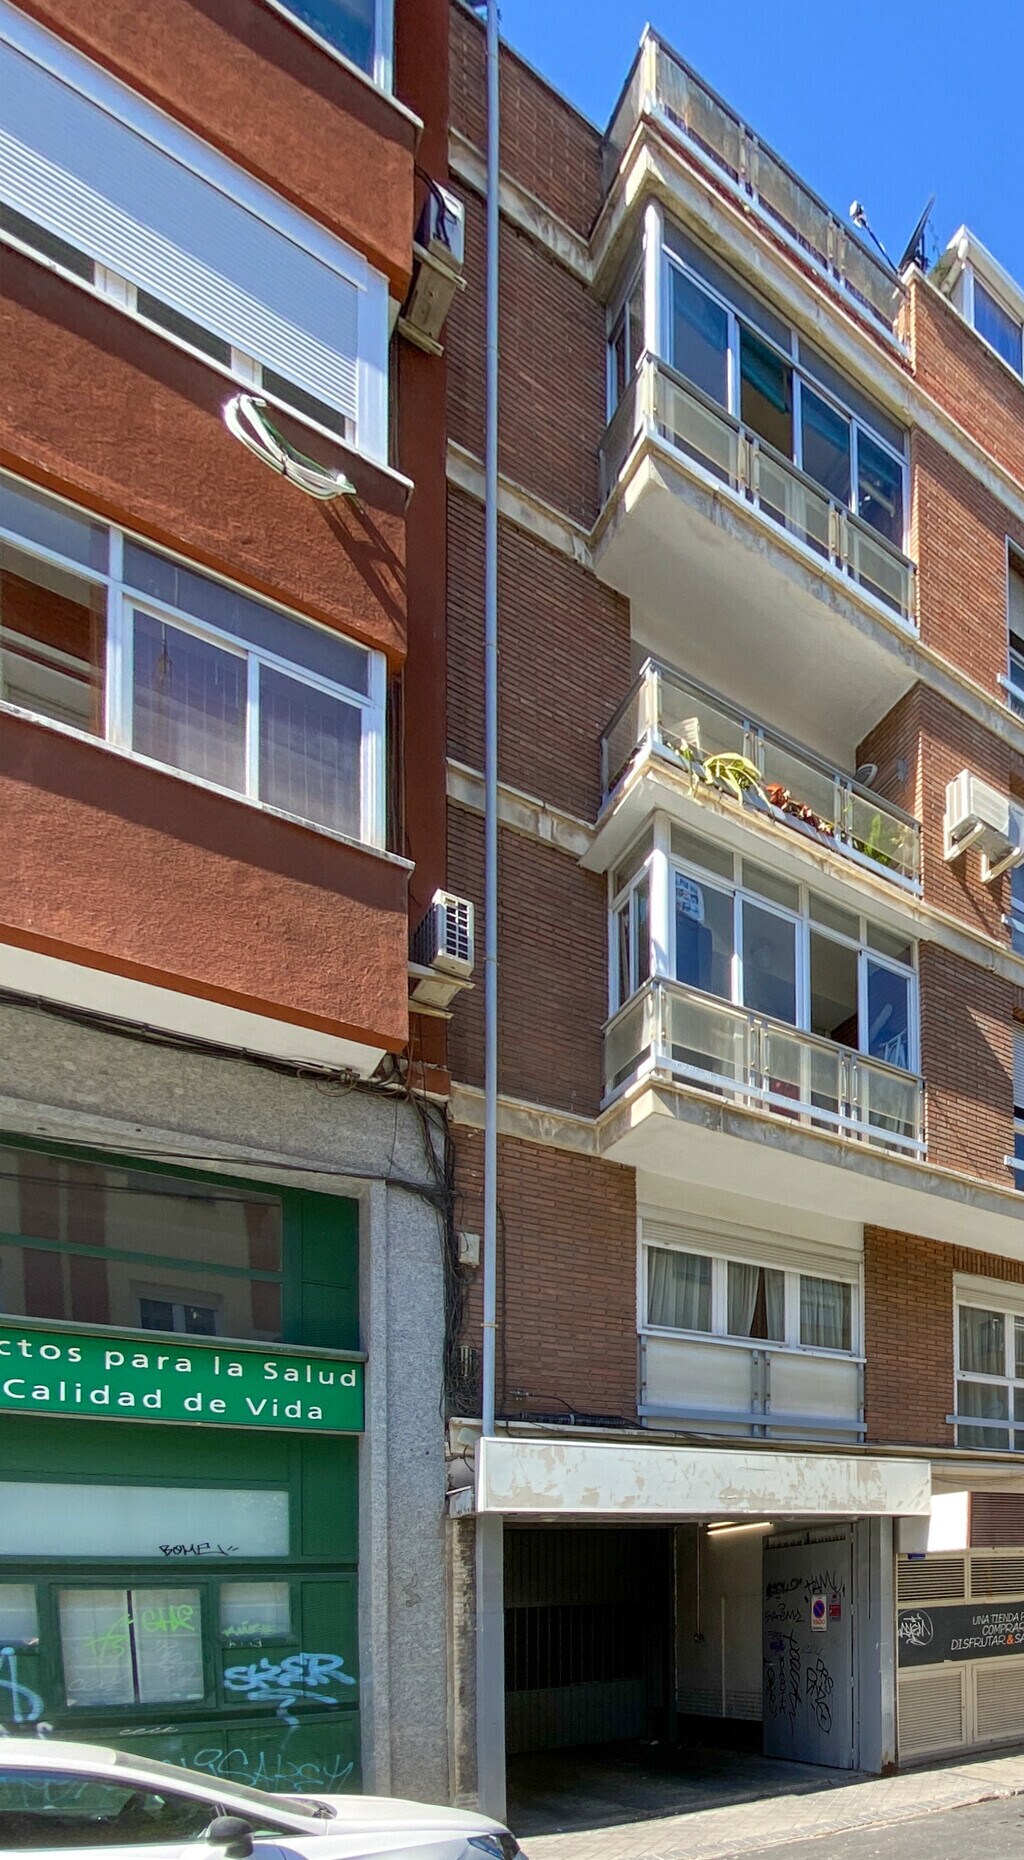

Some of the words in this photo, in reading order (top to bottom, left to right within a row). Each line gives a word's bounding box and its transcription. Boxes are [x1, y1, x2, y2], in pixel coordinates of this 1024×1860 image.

[105, 1350, 192, 1372] para
[214, 1356, 243, 1377] la
[263, 1361, 357, 1387] Salud
[3, 1378, 162, 1409] Calidad
[183, 1392, 227, 1413] de
[245, 1397, 323, 1420] Vida
[973, 1615, 990, 1625] UNA
[990, 1613, 1020, 1624] TIENDA
[951, 1635, 1006, 1650] DISFRUTAR
[1006, 1634, 1015, 1645] &
